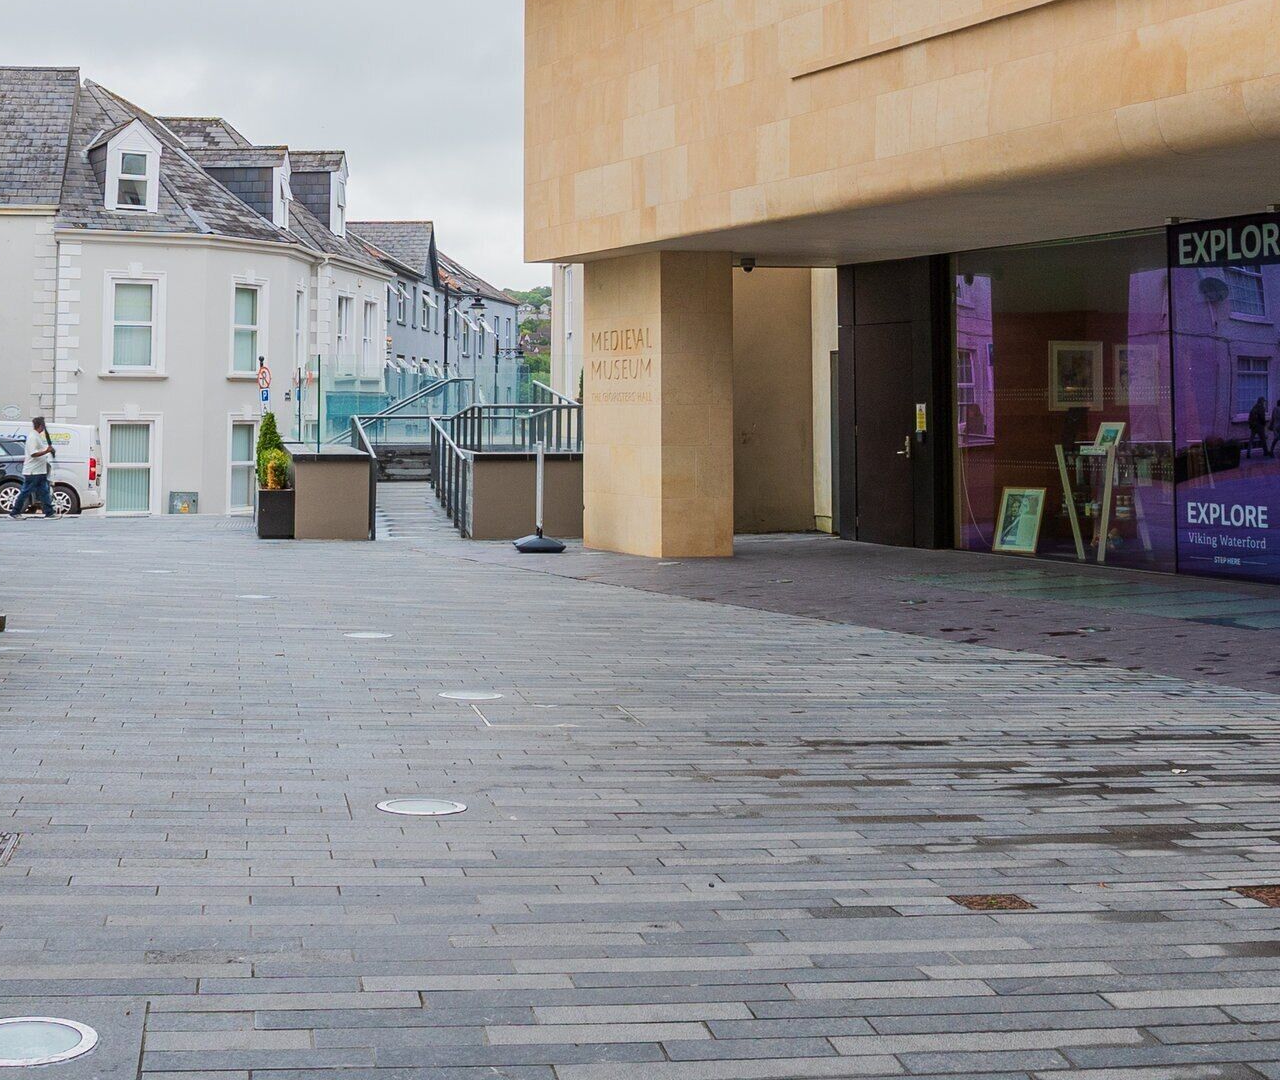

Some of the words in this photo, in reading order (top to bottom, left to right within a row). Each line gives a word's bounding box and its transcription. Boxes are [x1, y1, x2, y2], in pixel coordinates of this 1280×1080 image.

[591, 327, 652, 353] MEDIEVAL
[591, 358, 652, 381] MUSEUM
[1187, 501, 1269, 529] EXPLORE
[1188, 532, 1218, 549] Viking
[1219, 535, 1267, 550] Waterford
[1214, 556, 1227, 565] STEP
[1227, 557, 1241, 566] HERE
